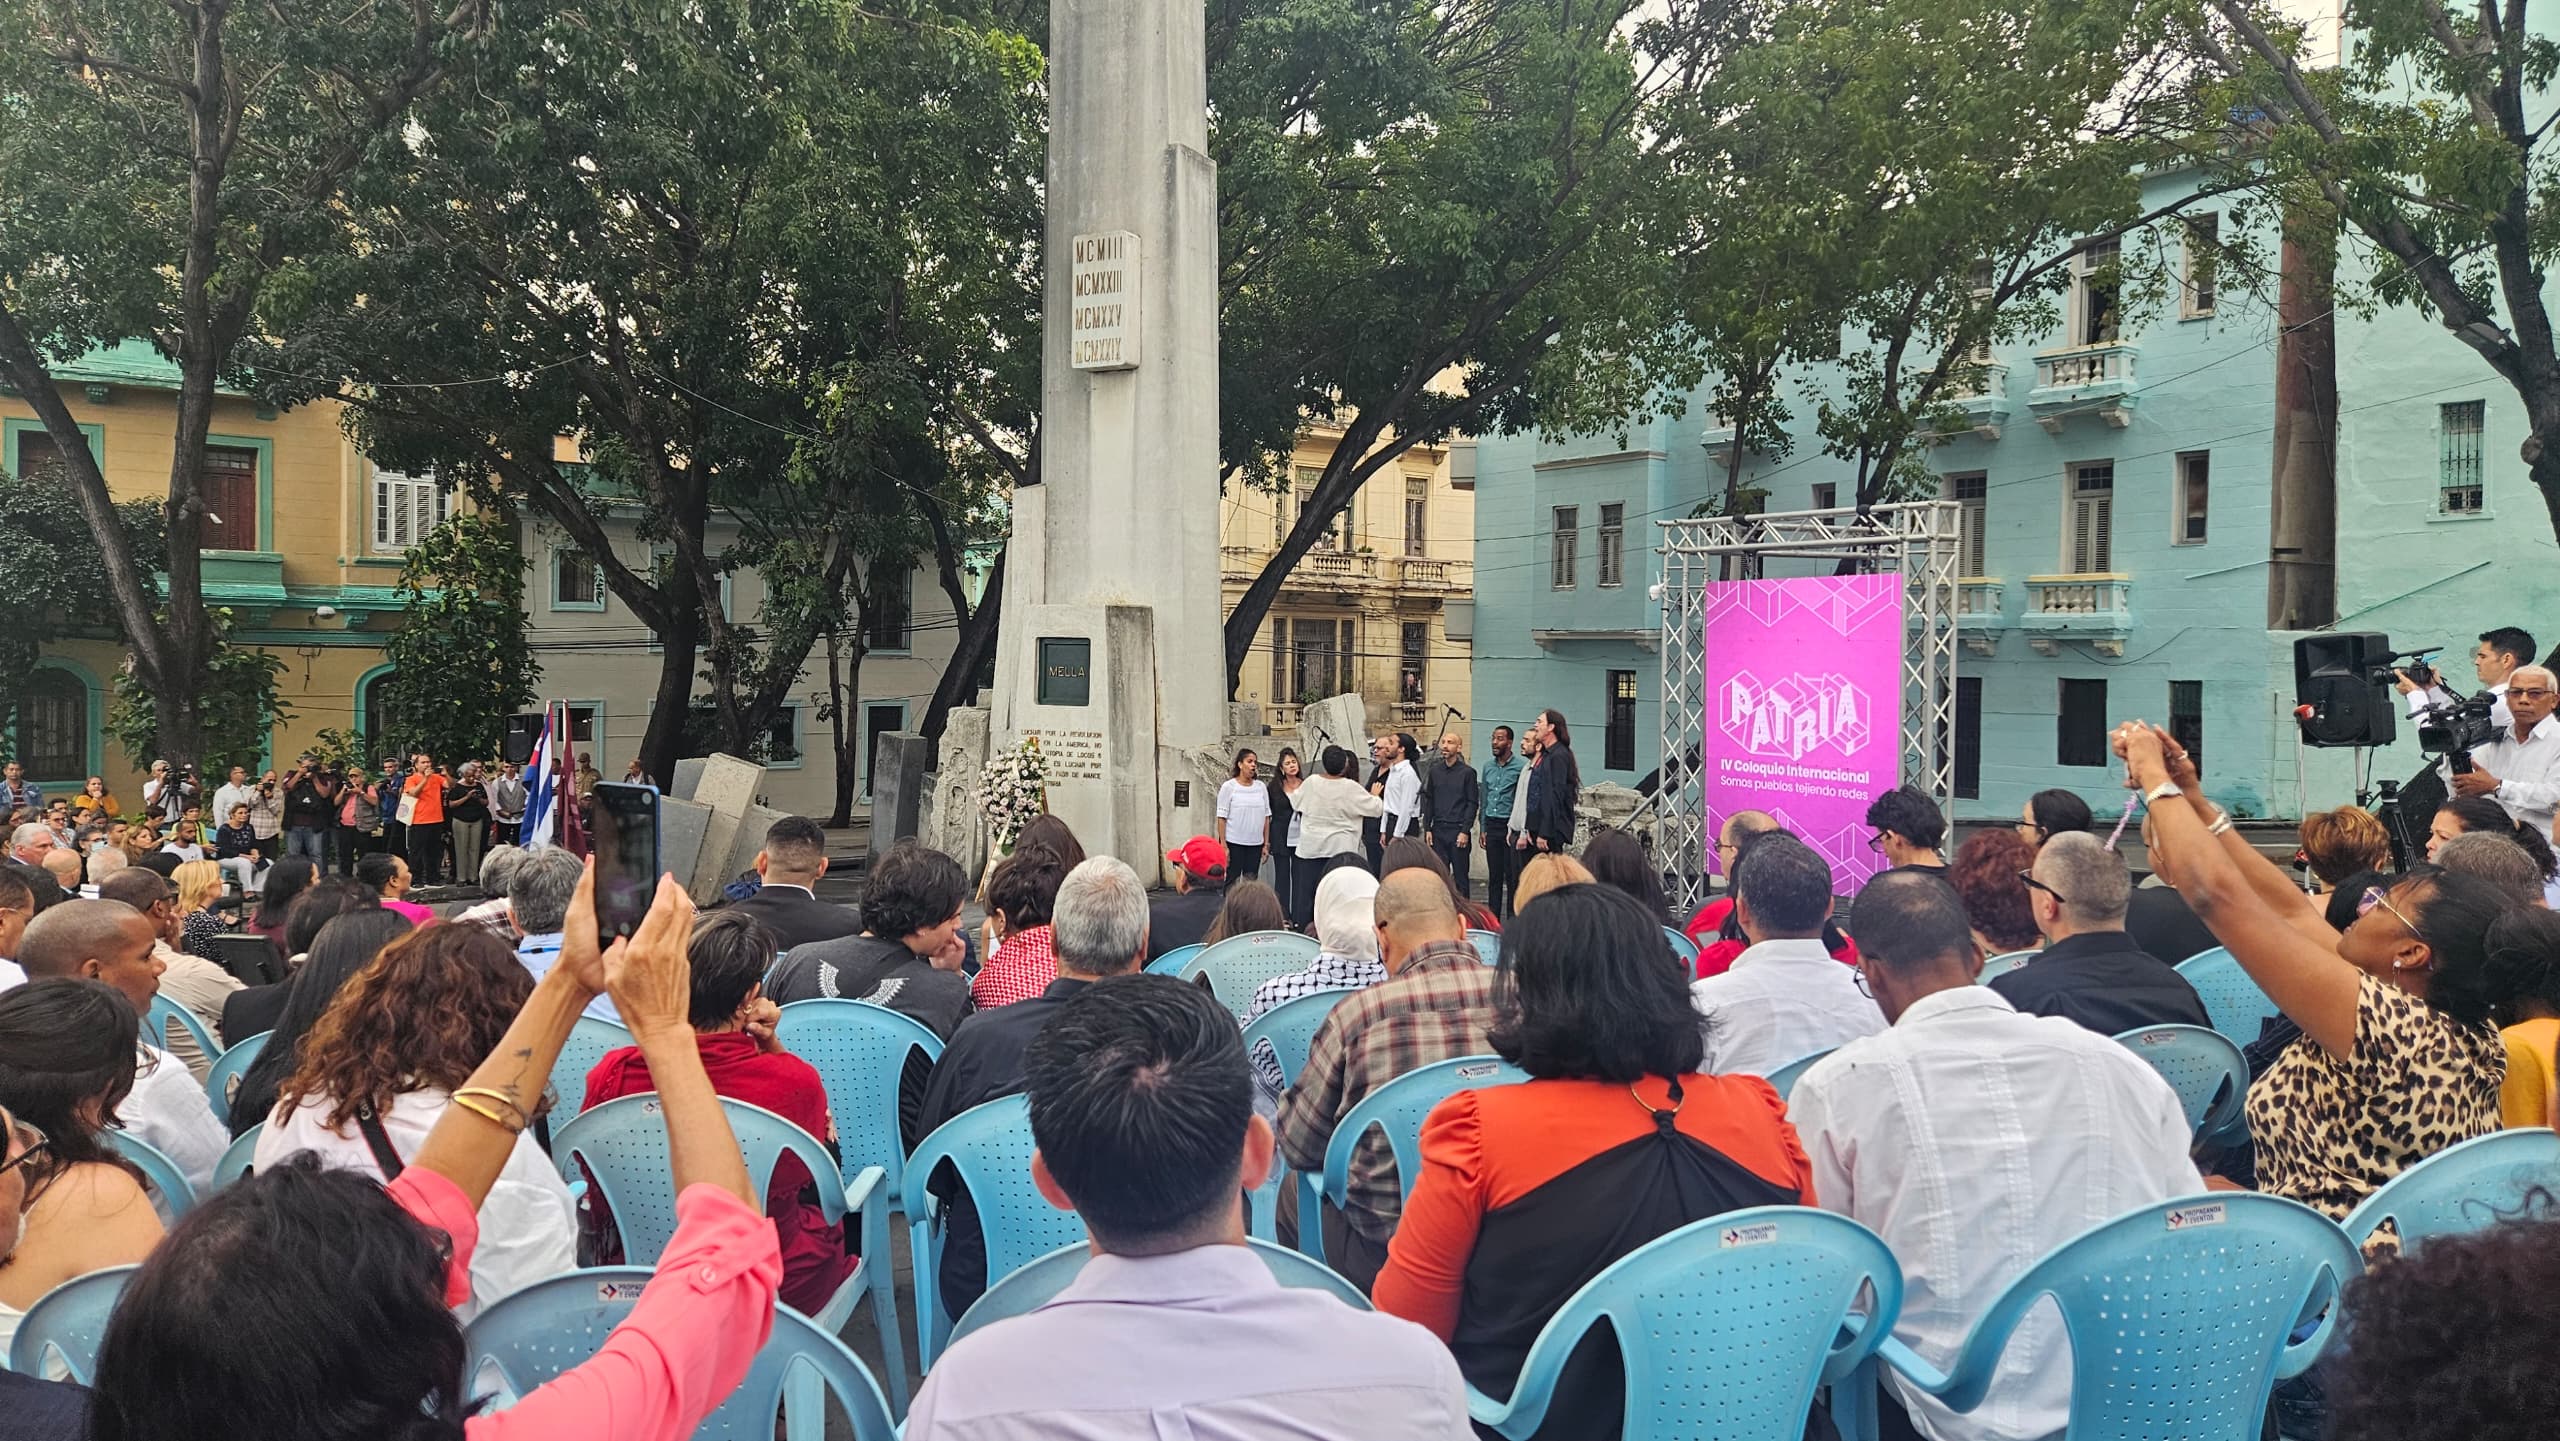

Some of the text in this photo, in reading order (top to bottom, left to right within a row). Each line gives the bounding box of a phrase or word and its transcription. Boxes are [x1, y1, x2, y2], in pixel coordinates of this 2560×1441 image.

[1076, 236, 1123, 264] MCMIII
[1076, 270, 1122, 297] MCMXXIII
[1075, 304, 1122, 330] MCMXXV
[1049, 666, 1085, 677] MELLA
[1728, 676, 1862, 761] PATRIA
[1720, 758, 1870, 784] IV Coloquio Internacional
[1720, 775, 1869, 800] Somos pueblos tejiendo redes
[2184, 1205, 2222, 1217] PROPAGANDA
[2190, 1214, 2214, 1224] EVENTOS
